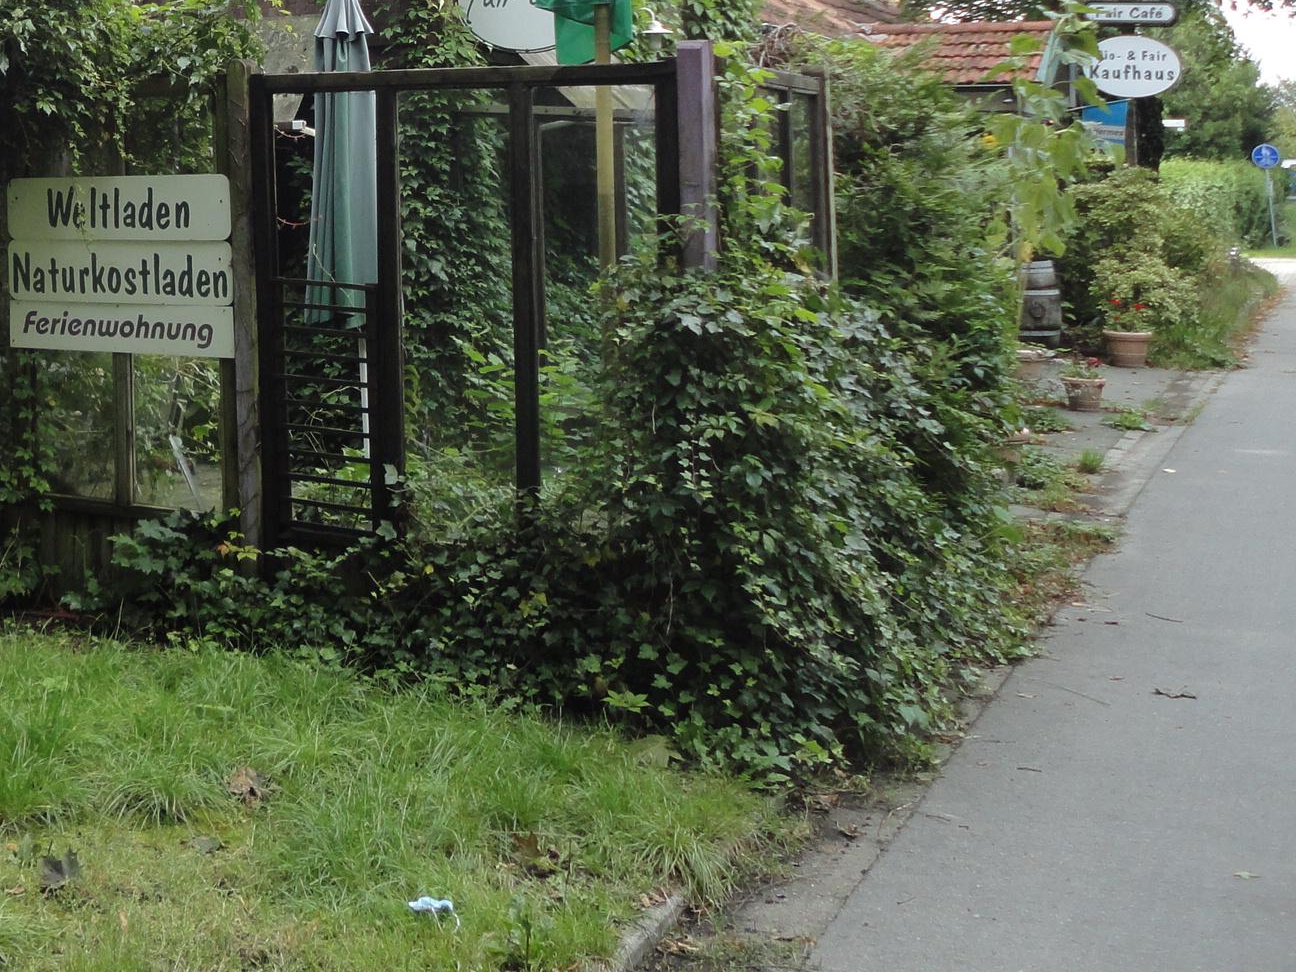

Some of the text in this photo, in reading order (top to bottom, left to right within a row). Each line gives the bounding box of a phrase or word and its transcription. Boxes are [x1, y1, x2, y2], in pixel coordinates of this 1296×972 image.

[1129, 6, 1163, 19] Café
[1126, 50, 1136, 61] &
[1141, 50, 1167, 61] Fair
[1089, 64, 1175, 81] Kaufhaus
[47, 186, 191, 231] Weltladen
[12, 251, 228, 299] Naturkostladen
[22, 310, 214, 349] Ferienwohnung
